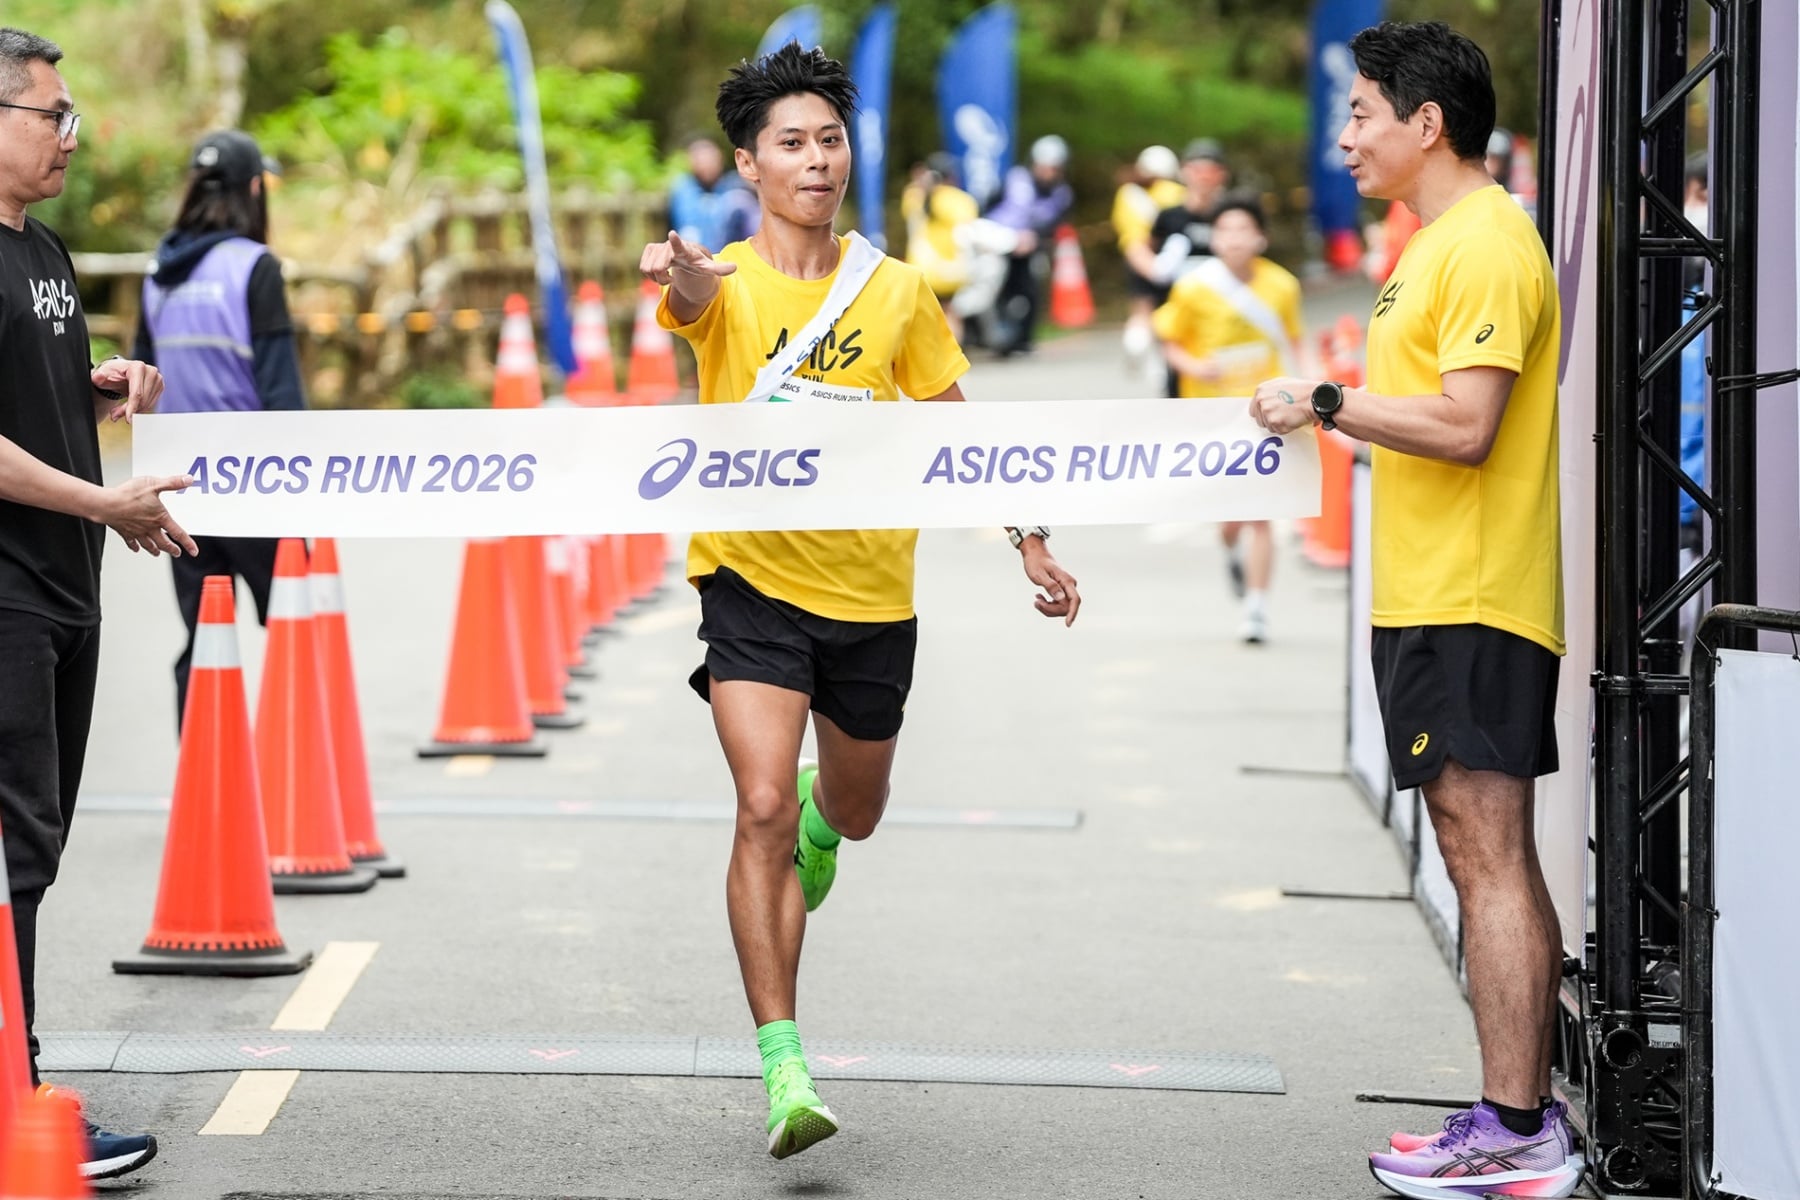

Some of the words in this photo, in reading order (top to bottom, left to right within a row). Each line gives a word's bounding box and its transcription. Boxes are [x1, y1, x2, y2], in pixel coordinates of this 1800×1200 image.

[28, 278, 75, 319] ASICS
[766, 328, 863, 372] AICS
[810, 390, 832, 400] ASICS
[832, 393, 848, 402] RUN
[176, 456, 312, 494] ASICS
[320, 455, 416, 493] RUN
[421, 453, 537, 492] 2026
[698, 448, 821, 488] asics
[923, 445, 1056, 485] ASICS
[1066, 444, 1163, 482] RUN
[1168, 436, 1283, 477] 2026
